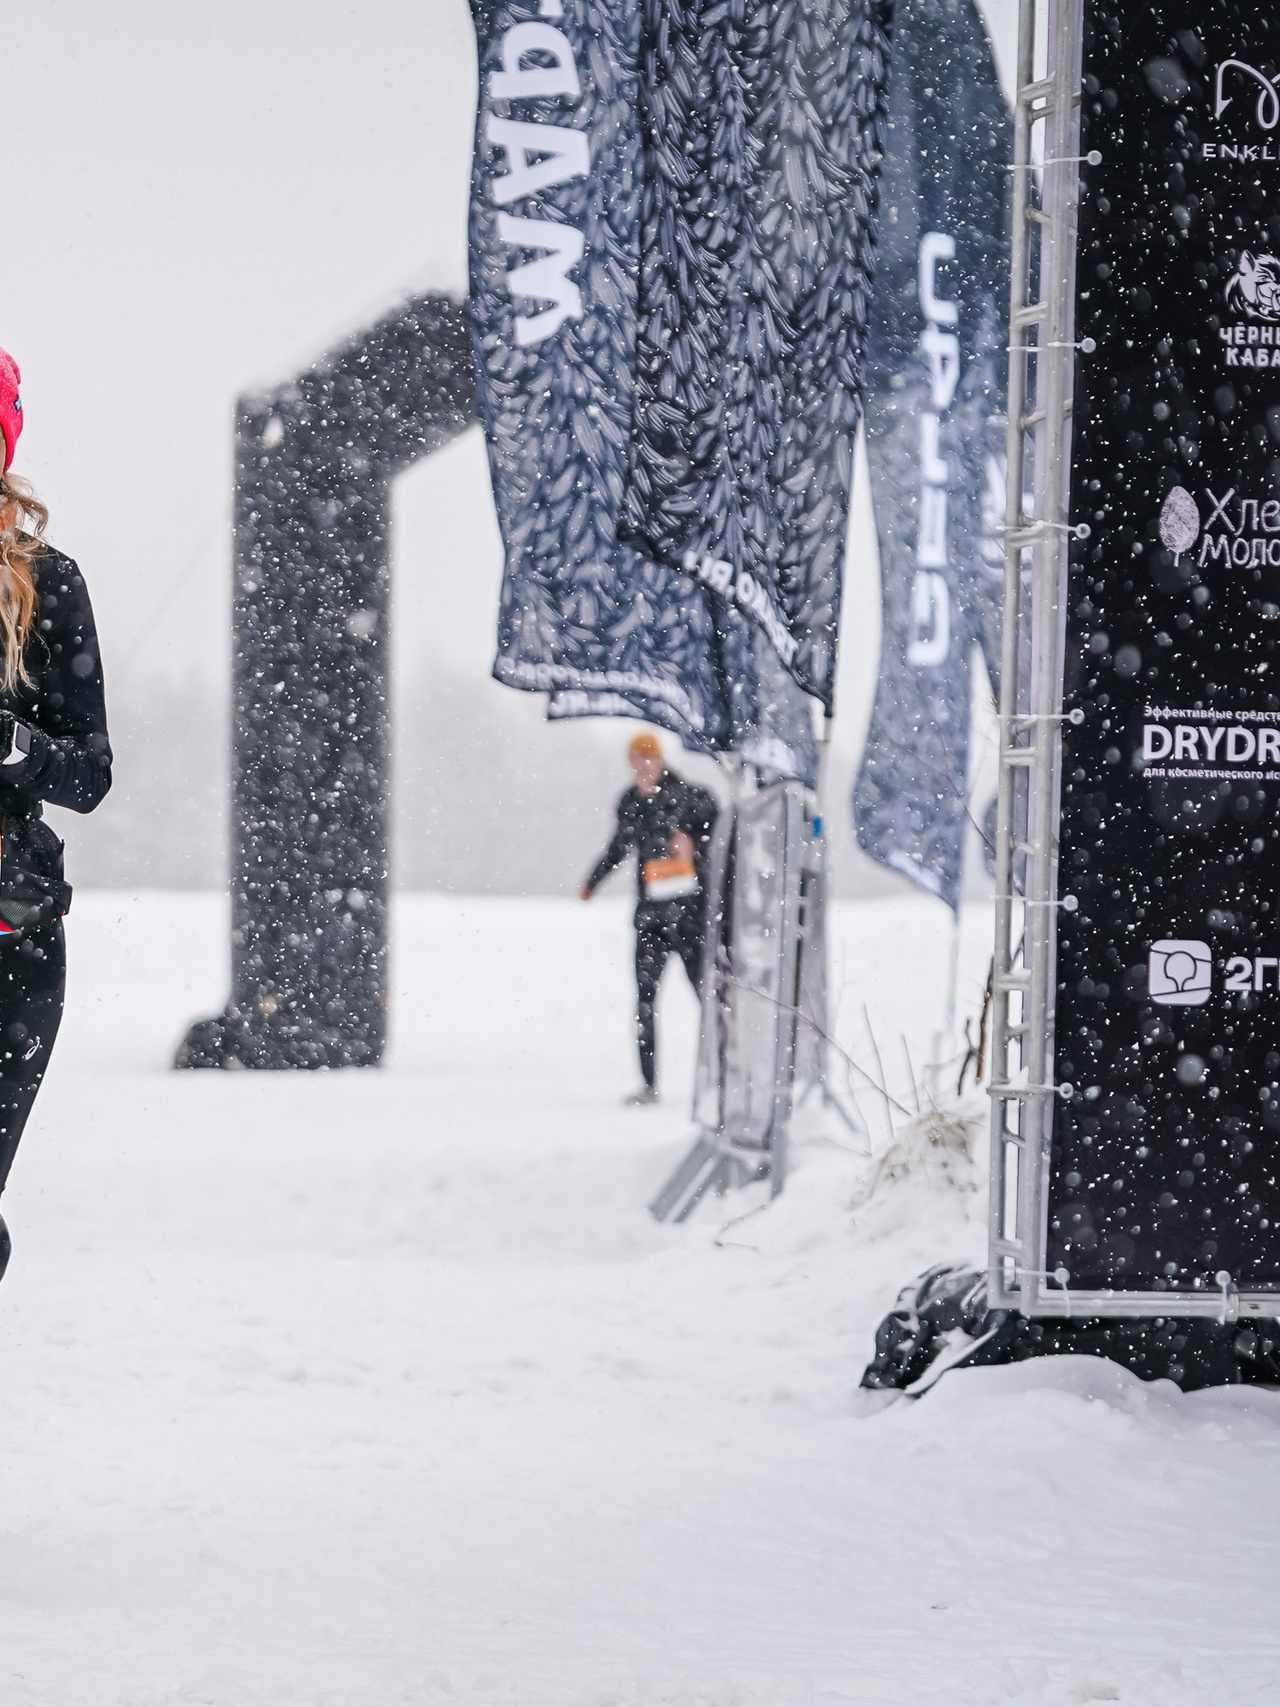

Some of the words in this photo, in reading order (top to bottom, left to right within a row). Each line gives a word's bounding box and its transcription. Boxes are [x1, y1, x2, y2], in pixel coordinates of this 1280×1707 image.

[1202, 143, 1280, 160] ENKL
[1143, 705, 1234, 721] Эффективные
[1142, 724, 1280, 762] DRYDR
[1142, 767, 1166, 778] для
[1168, 767, 1264, 779] косметического
[1225, 955, 1280, 991] 2Г
